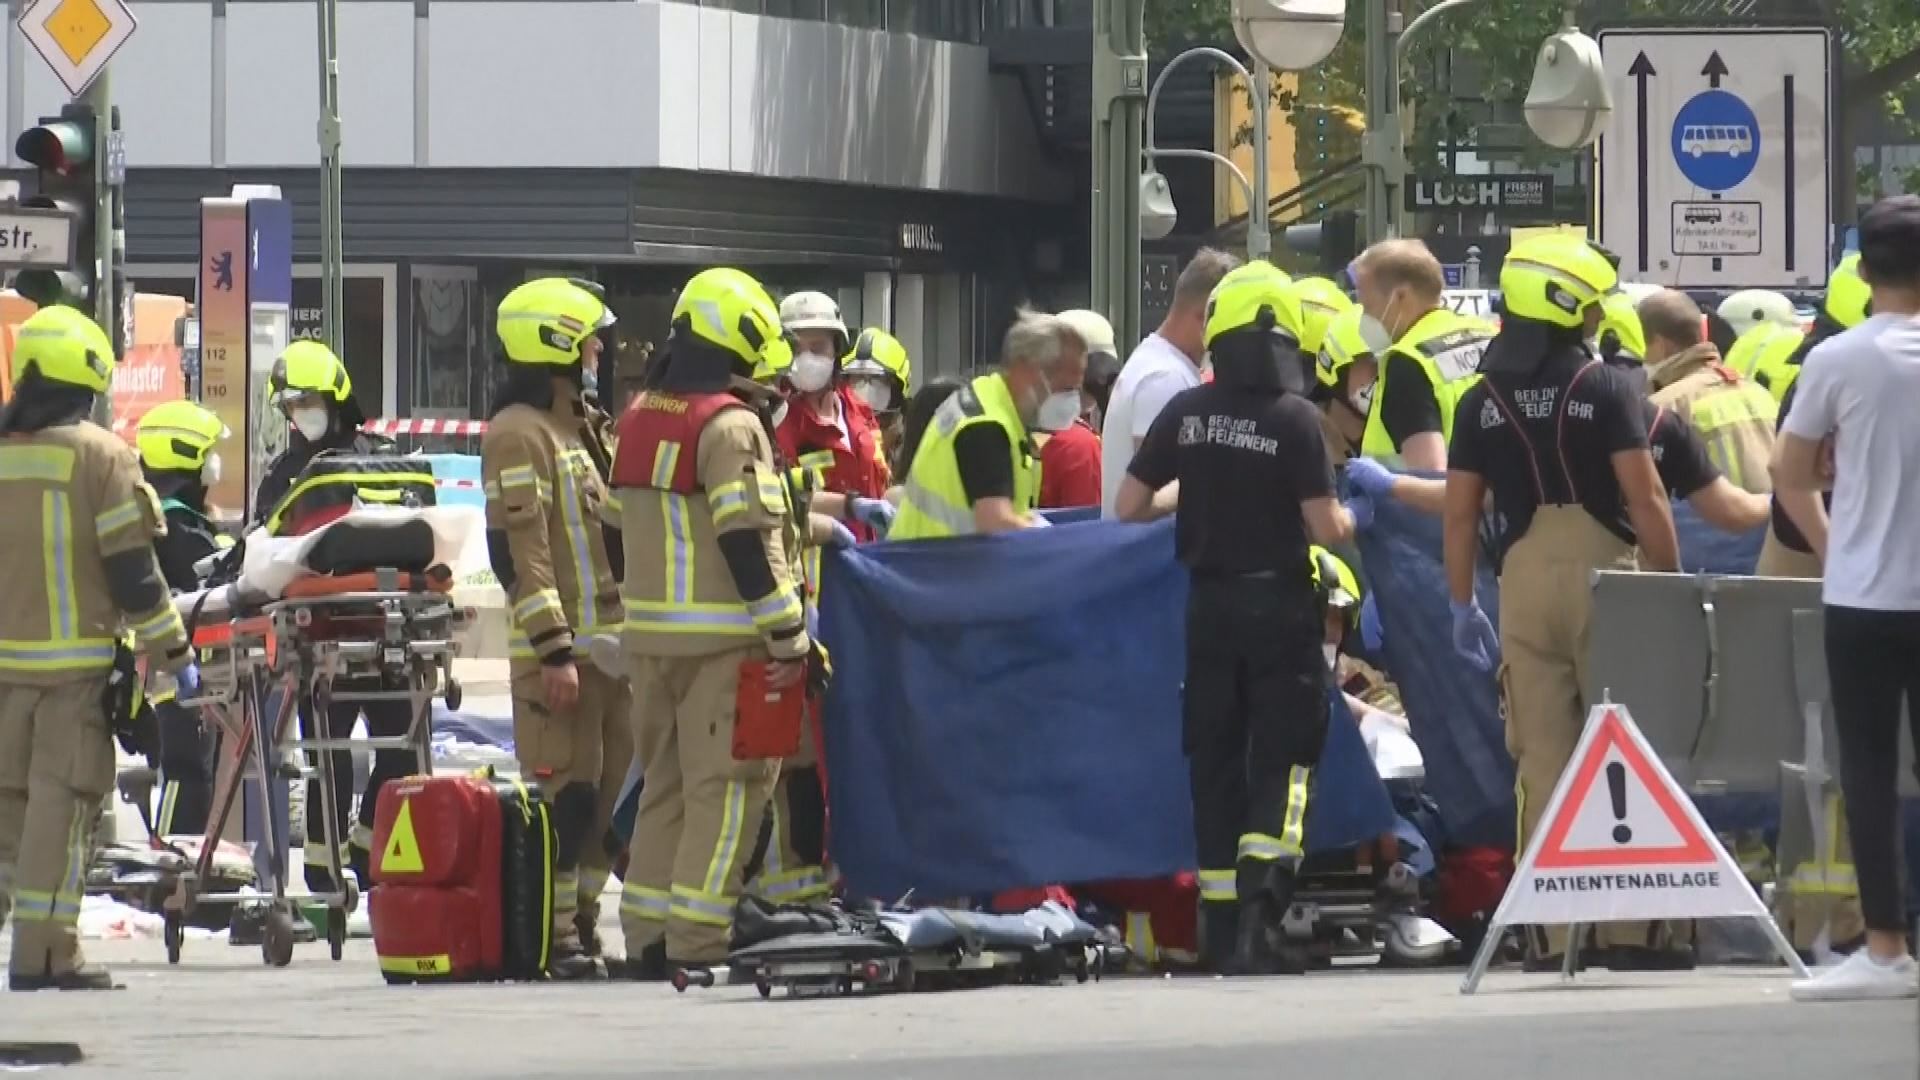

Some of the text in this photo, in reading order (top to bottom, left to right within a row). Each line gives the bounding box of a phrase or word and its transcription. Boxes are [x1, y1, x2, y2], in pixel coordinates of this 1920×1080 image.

[206, 348, 226, 360] 112
[1453, 346, 1485, 372] NOT
[206, 384, 227, 396] 110
[1206, 426, 1278, 456] FEUERWEHR
[1534, 870, 1720, 893] PATIENTENABLAGE
